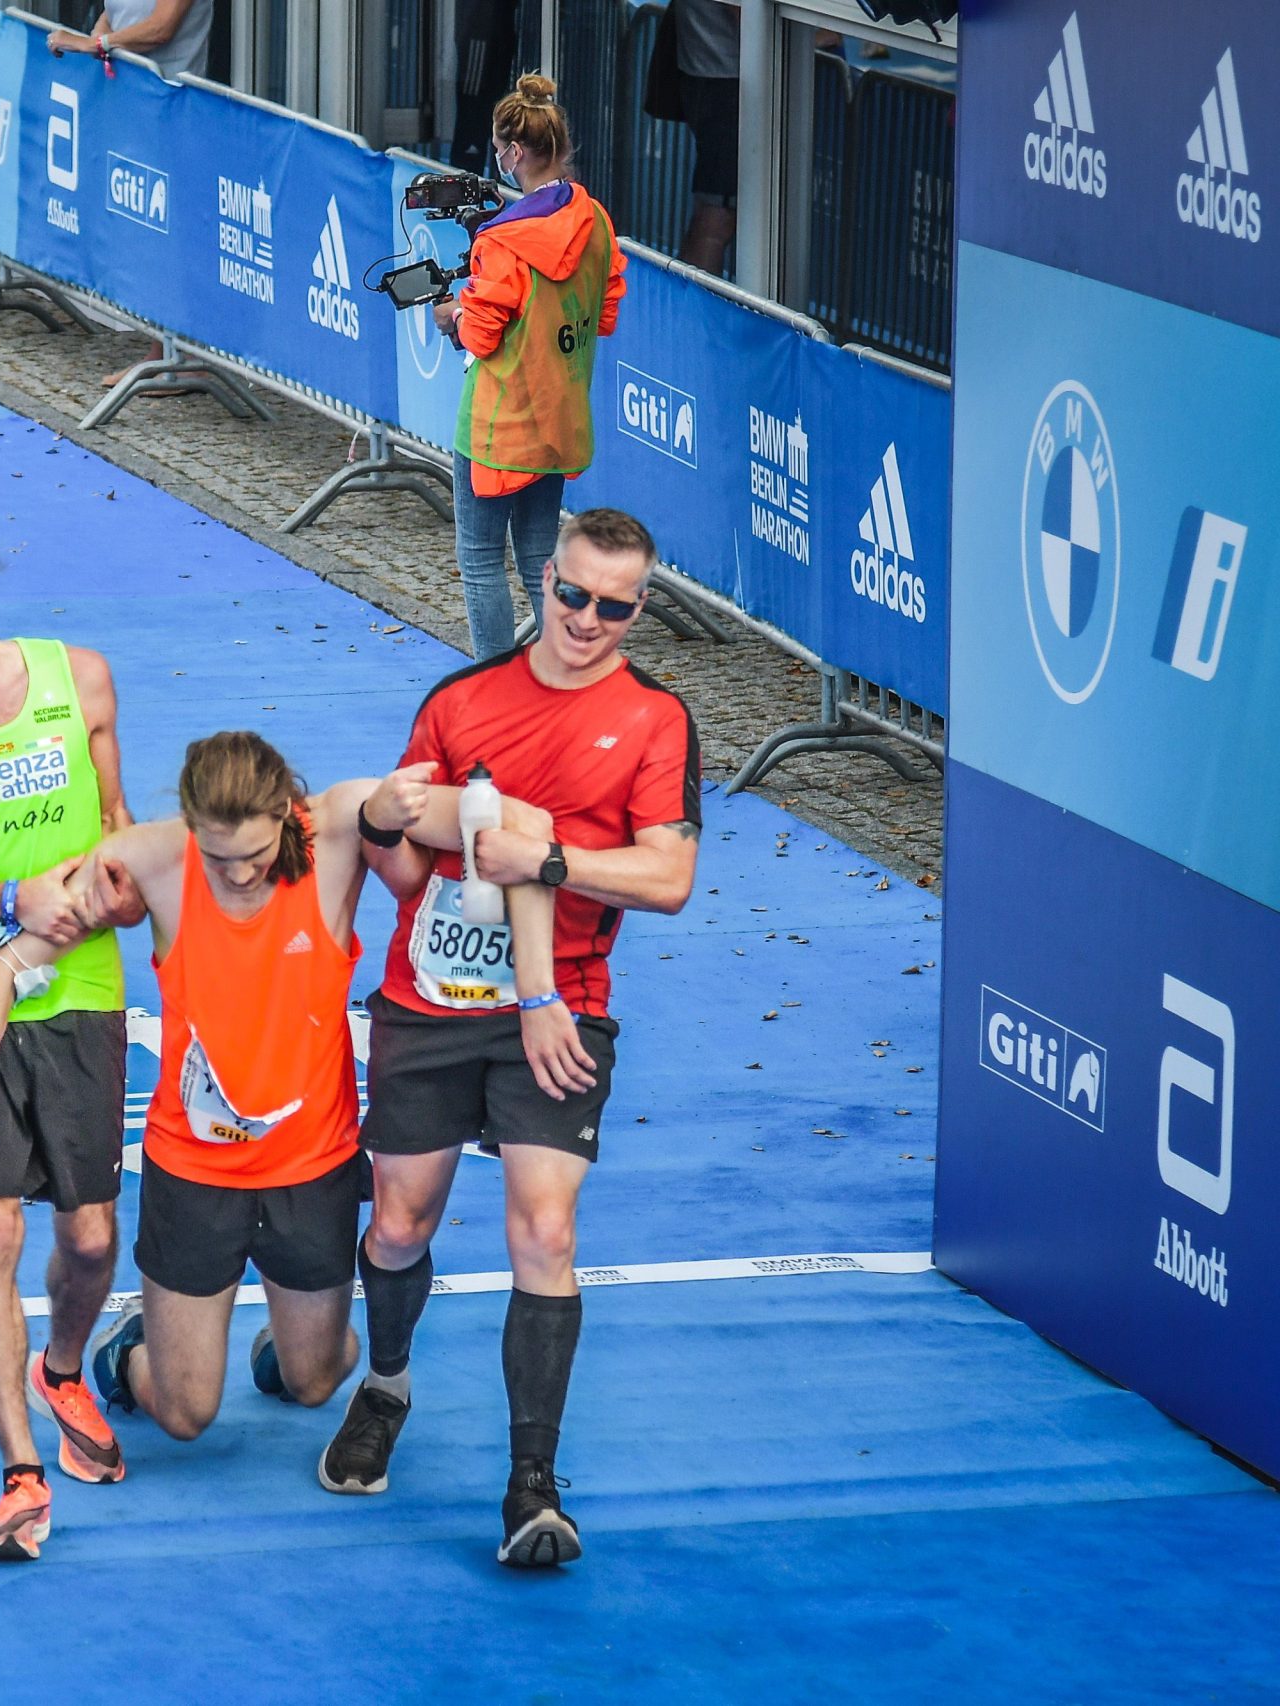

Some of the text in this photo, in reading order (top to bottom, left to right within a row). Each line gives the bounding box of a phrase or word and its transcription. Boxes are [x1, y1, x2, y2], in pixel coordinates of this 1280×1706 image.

[110, 167, 145, 213] Giti
[1024, 123, 1107, 198] adidas
[47, 198, 79, 234] Abbott
[219, 176, 251, 225] BMW
[1177, 163, 1261, 243] adidas
[219, 222, 253, 262] BERLIN
[220, 256, 274, 304] MARATHON
[308, 279, 359, 341] adidas
[623, 382, 667, 441] Giti
[750, 405, 785, 467] BMW
[1039, 398, 1111, 491] BMW
[751, 460, 787, 511] BERLIN
[751, 502, 809, 566] MARATHON
[851, 543, 926, 623] adidas
[440, 986, 475, 998] Giti
[450, 965, 484, 978] mark
[988, 1011, 1059, 1091] Giti
[213, 1127, 249, 1142] Giti
[1154, 1216, 1230, 1308] Abbott
